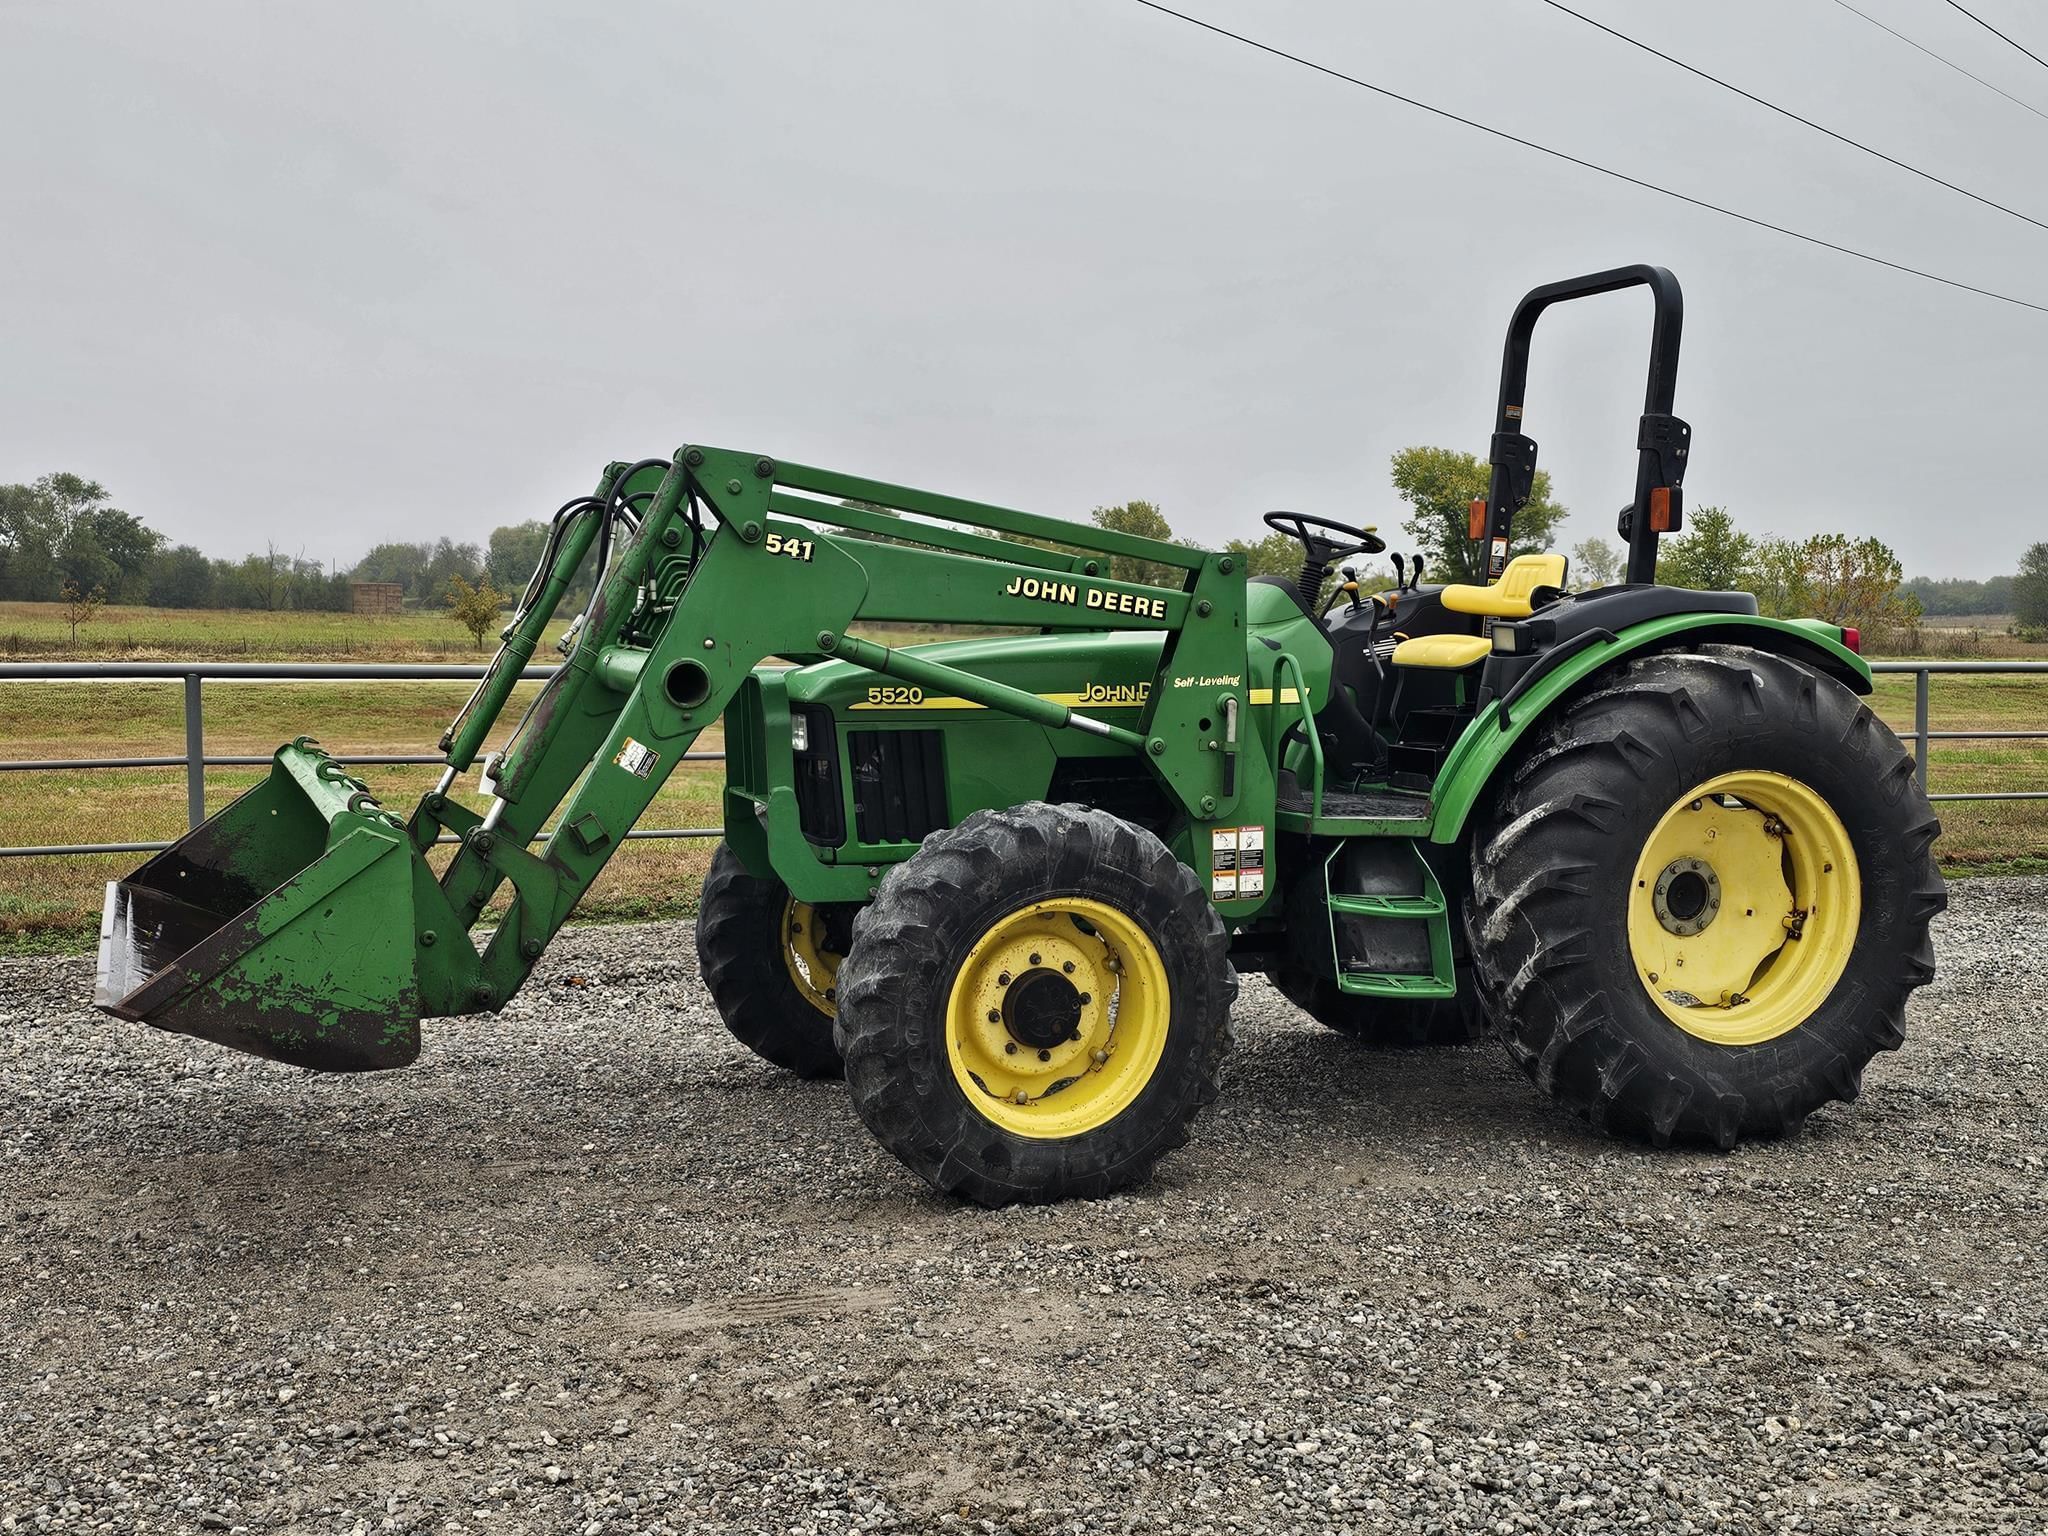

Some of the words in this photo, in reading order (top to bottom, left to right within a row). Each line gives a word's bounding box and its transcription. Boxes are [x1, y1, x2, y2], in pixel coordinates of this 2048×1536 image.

[765, 533, 813, 561] 541
[1006, 576, 1077, 604] JOHN
[1086, 588, 1165, 618] DEERE
[868, 687, 923, 703] 5520
